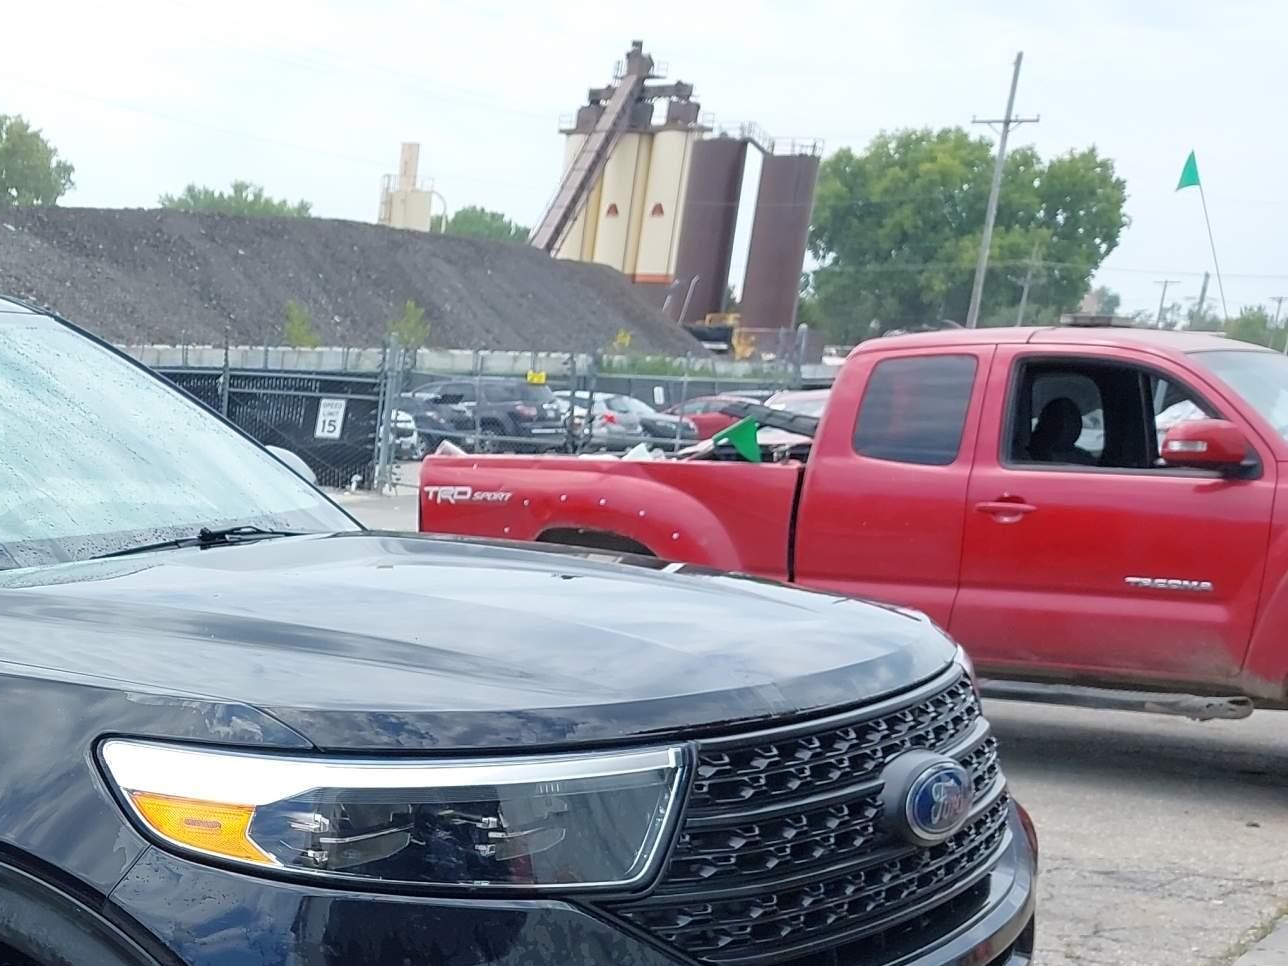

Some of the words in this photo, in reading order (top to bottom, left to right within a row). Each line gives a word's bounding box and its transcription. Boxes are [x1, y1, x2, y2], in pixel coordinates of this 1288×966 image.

[321, 419, 337, 434] 15
[423, 485, 472, 505] TRD
[471, 492, 513, 504] SPORT
[1124, 576, 1213, 592] TACOMA
